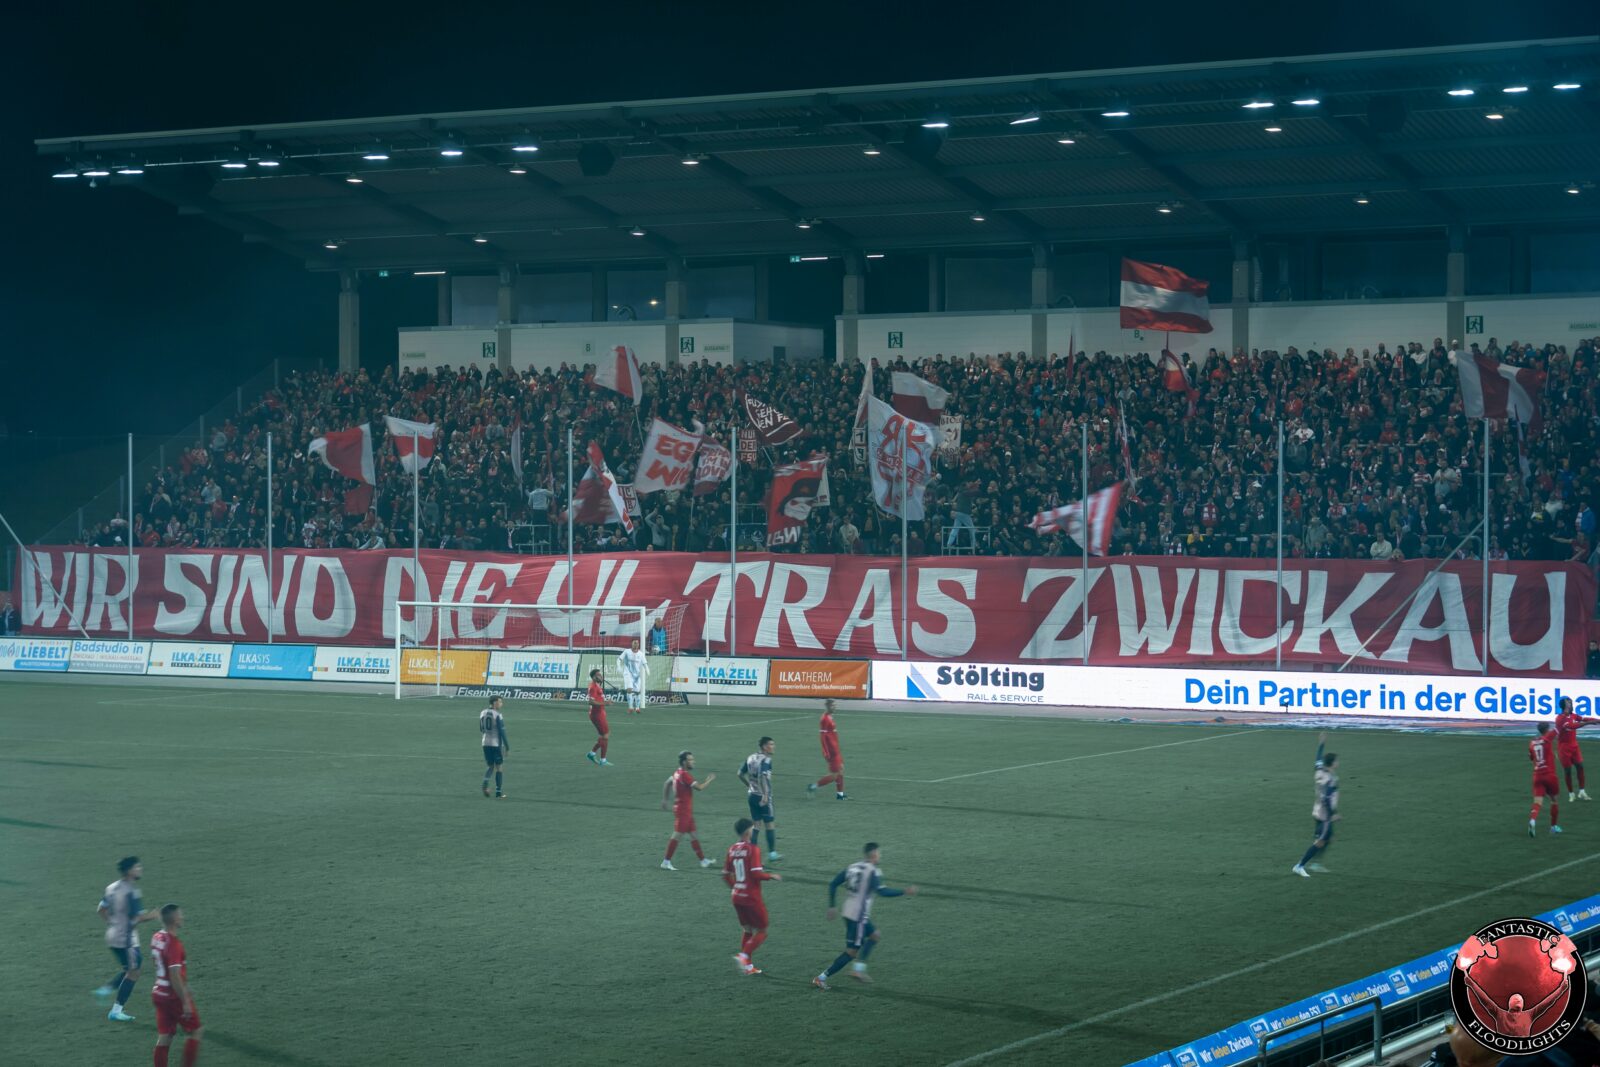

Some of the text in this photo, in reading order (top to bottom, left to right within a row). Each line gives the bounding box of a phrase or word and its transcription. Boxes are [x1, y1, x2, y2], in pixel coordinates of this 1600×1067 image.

[21, 552, 139, 631] WIR
[153, 554, 357, 638] SIND
[382, 557, 524, 642] DIE
[1018, 563, 1567, 672] ZWICKAU
[74, 641, 129, 654] Badstudio
[133, 643, 143, 654] in
[779, 671, 832, 683] ILKATHERM
[936, 665, 1045, 691] Stölting
[457, 686, 511, 698] Eisenbach
[967, 693, 1044, 703] RAIL & SERVICE
[1184, 678, 1600, 717] Dein Partner in der Gleisba
[1226, 1035, 1254, 1053] Zwickau
